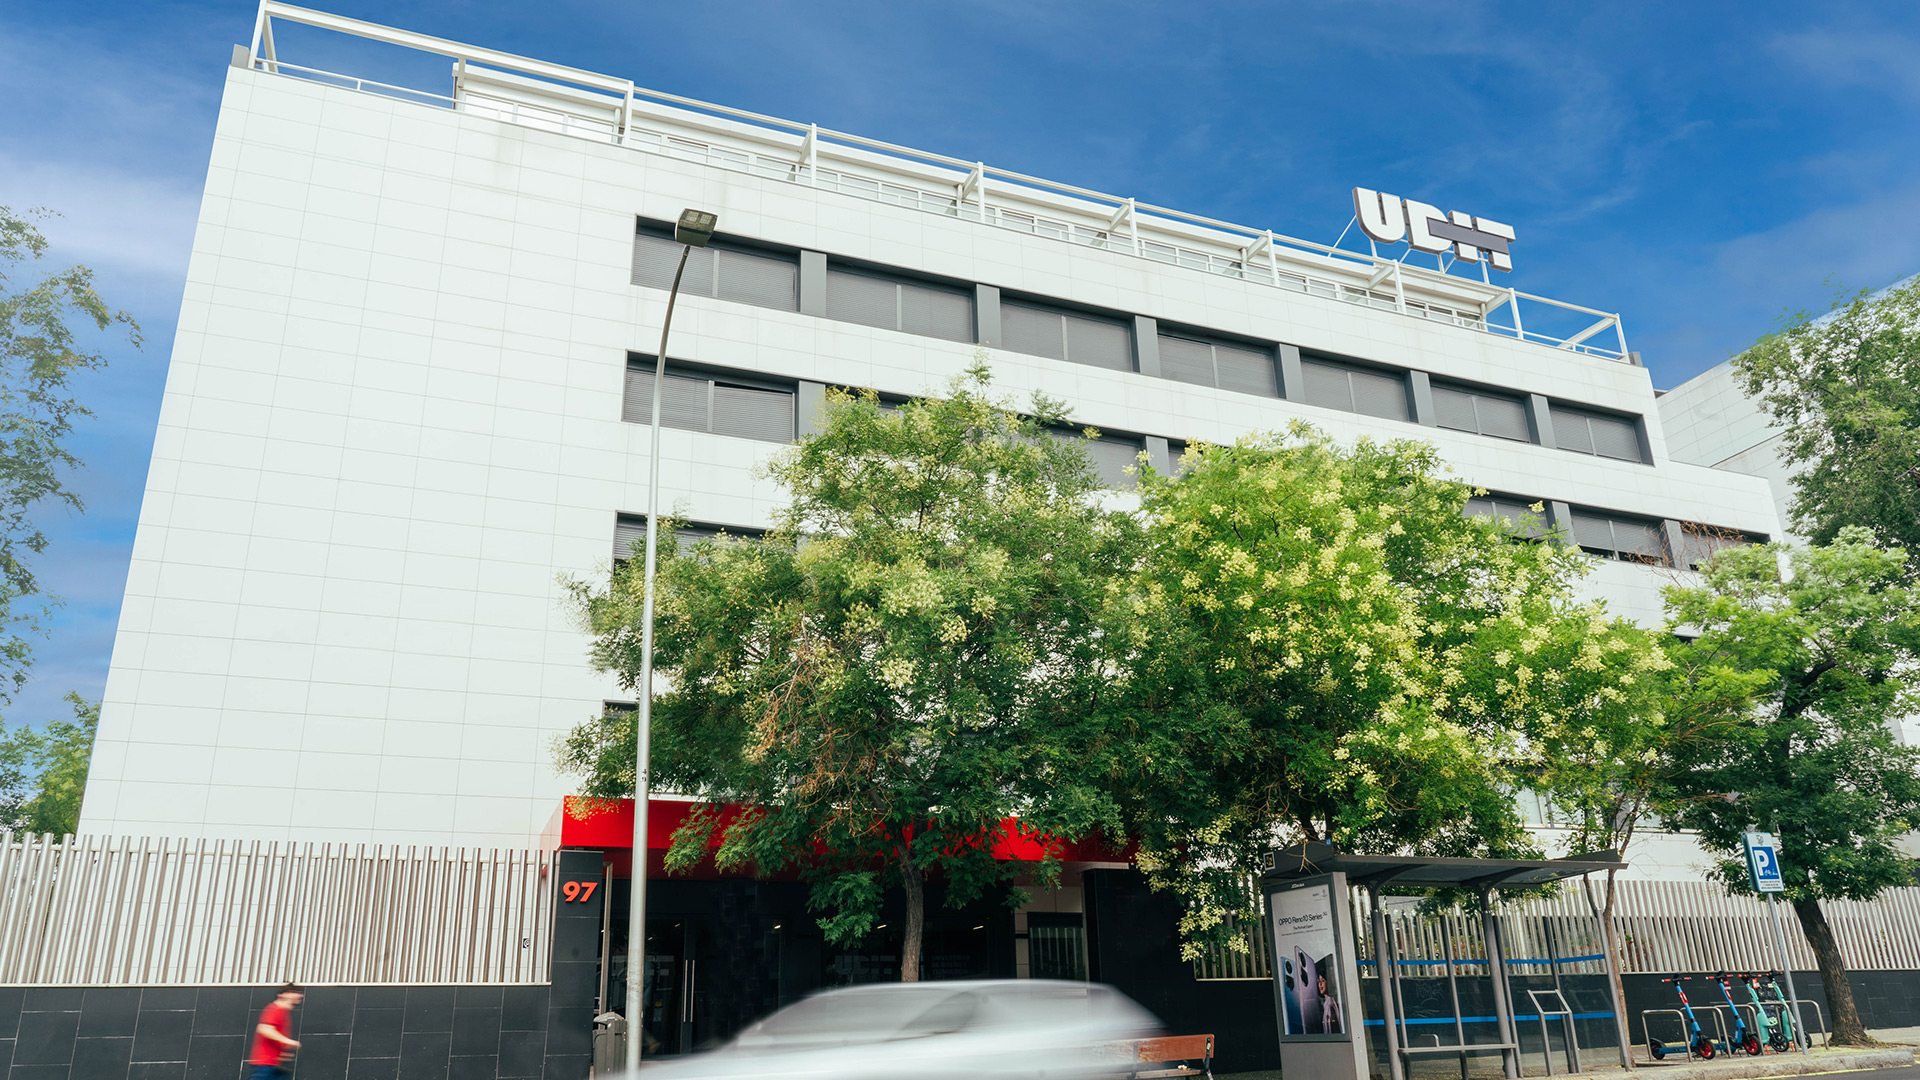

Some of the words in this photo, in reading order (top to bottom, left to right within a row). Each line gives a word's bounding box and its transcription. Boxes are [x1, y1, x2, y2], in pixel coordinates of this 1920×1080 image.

[1754, 850, 1769, 876] P
[562, 880, 598, 902] 97
[1279, 917, 1291, 925] OPPO
[1292, 914, 1308, 923] Reno10
[1308, 912, 1323, 921] Series
